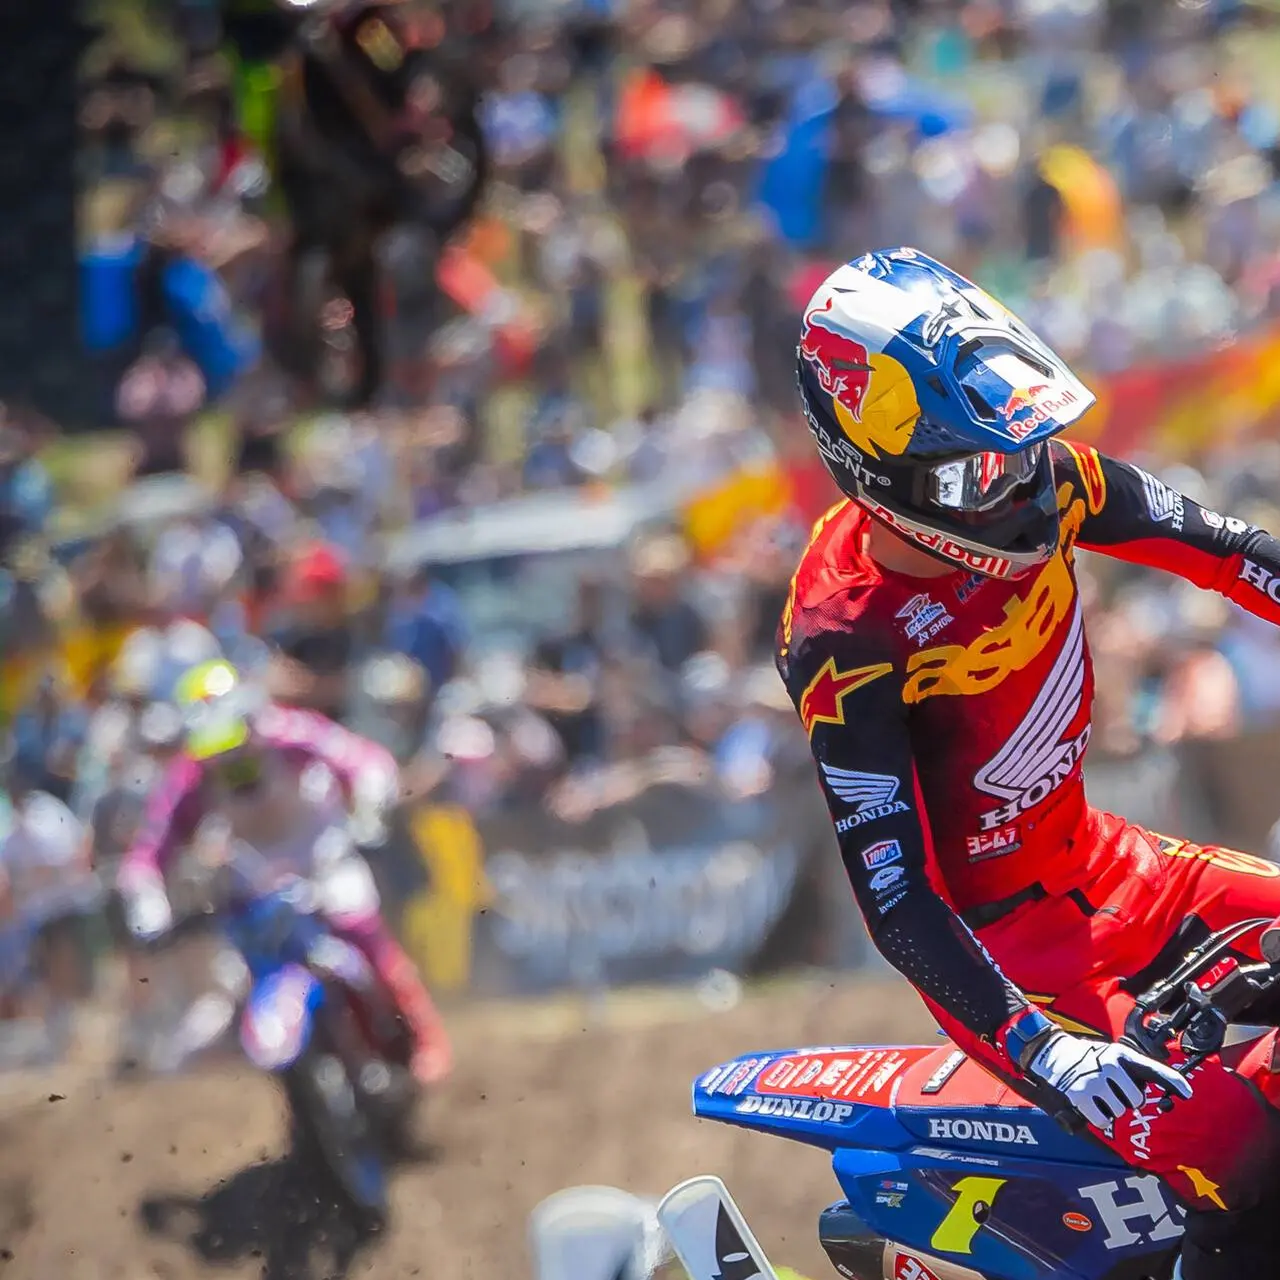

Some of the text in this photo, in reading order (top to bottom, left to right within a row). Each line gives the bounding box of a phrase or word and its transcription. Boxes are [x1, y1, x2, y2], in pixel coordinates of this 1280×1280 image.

[1009, 390, 1078, 439] Red Bull
[940, 541, 1011, 578] Bull
[980, 722, 1092, 830] HOND
[836, 801, 911, 833] HONDA
[736, 1096, 853, 1123] DUNLOP
[929, 1118, 1038, 1145] HONDA
[930, 1176, 1008, 1254] 1
